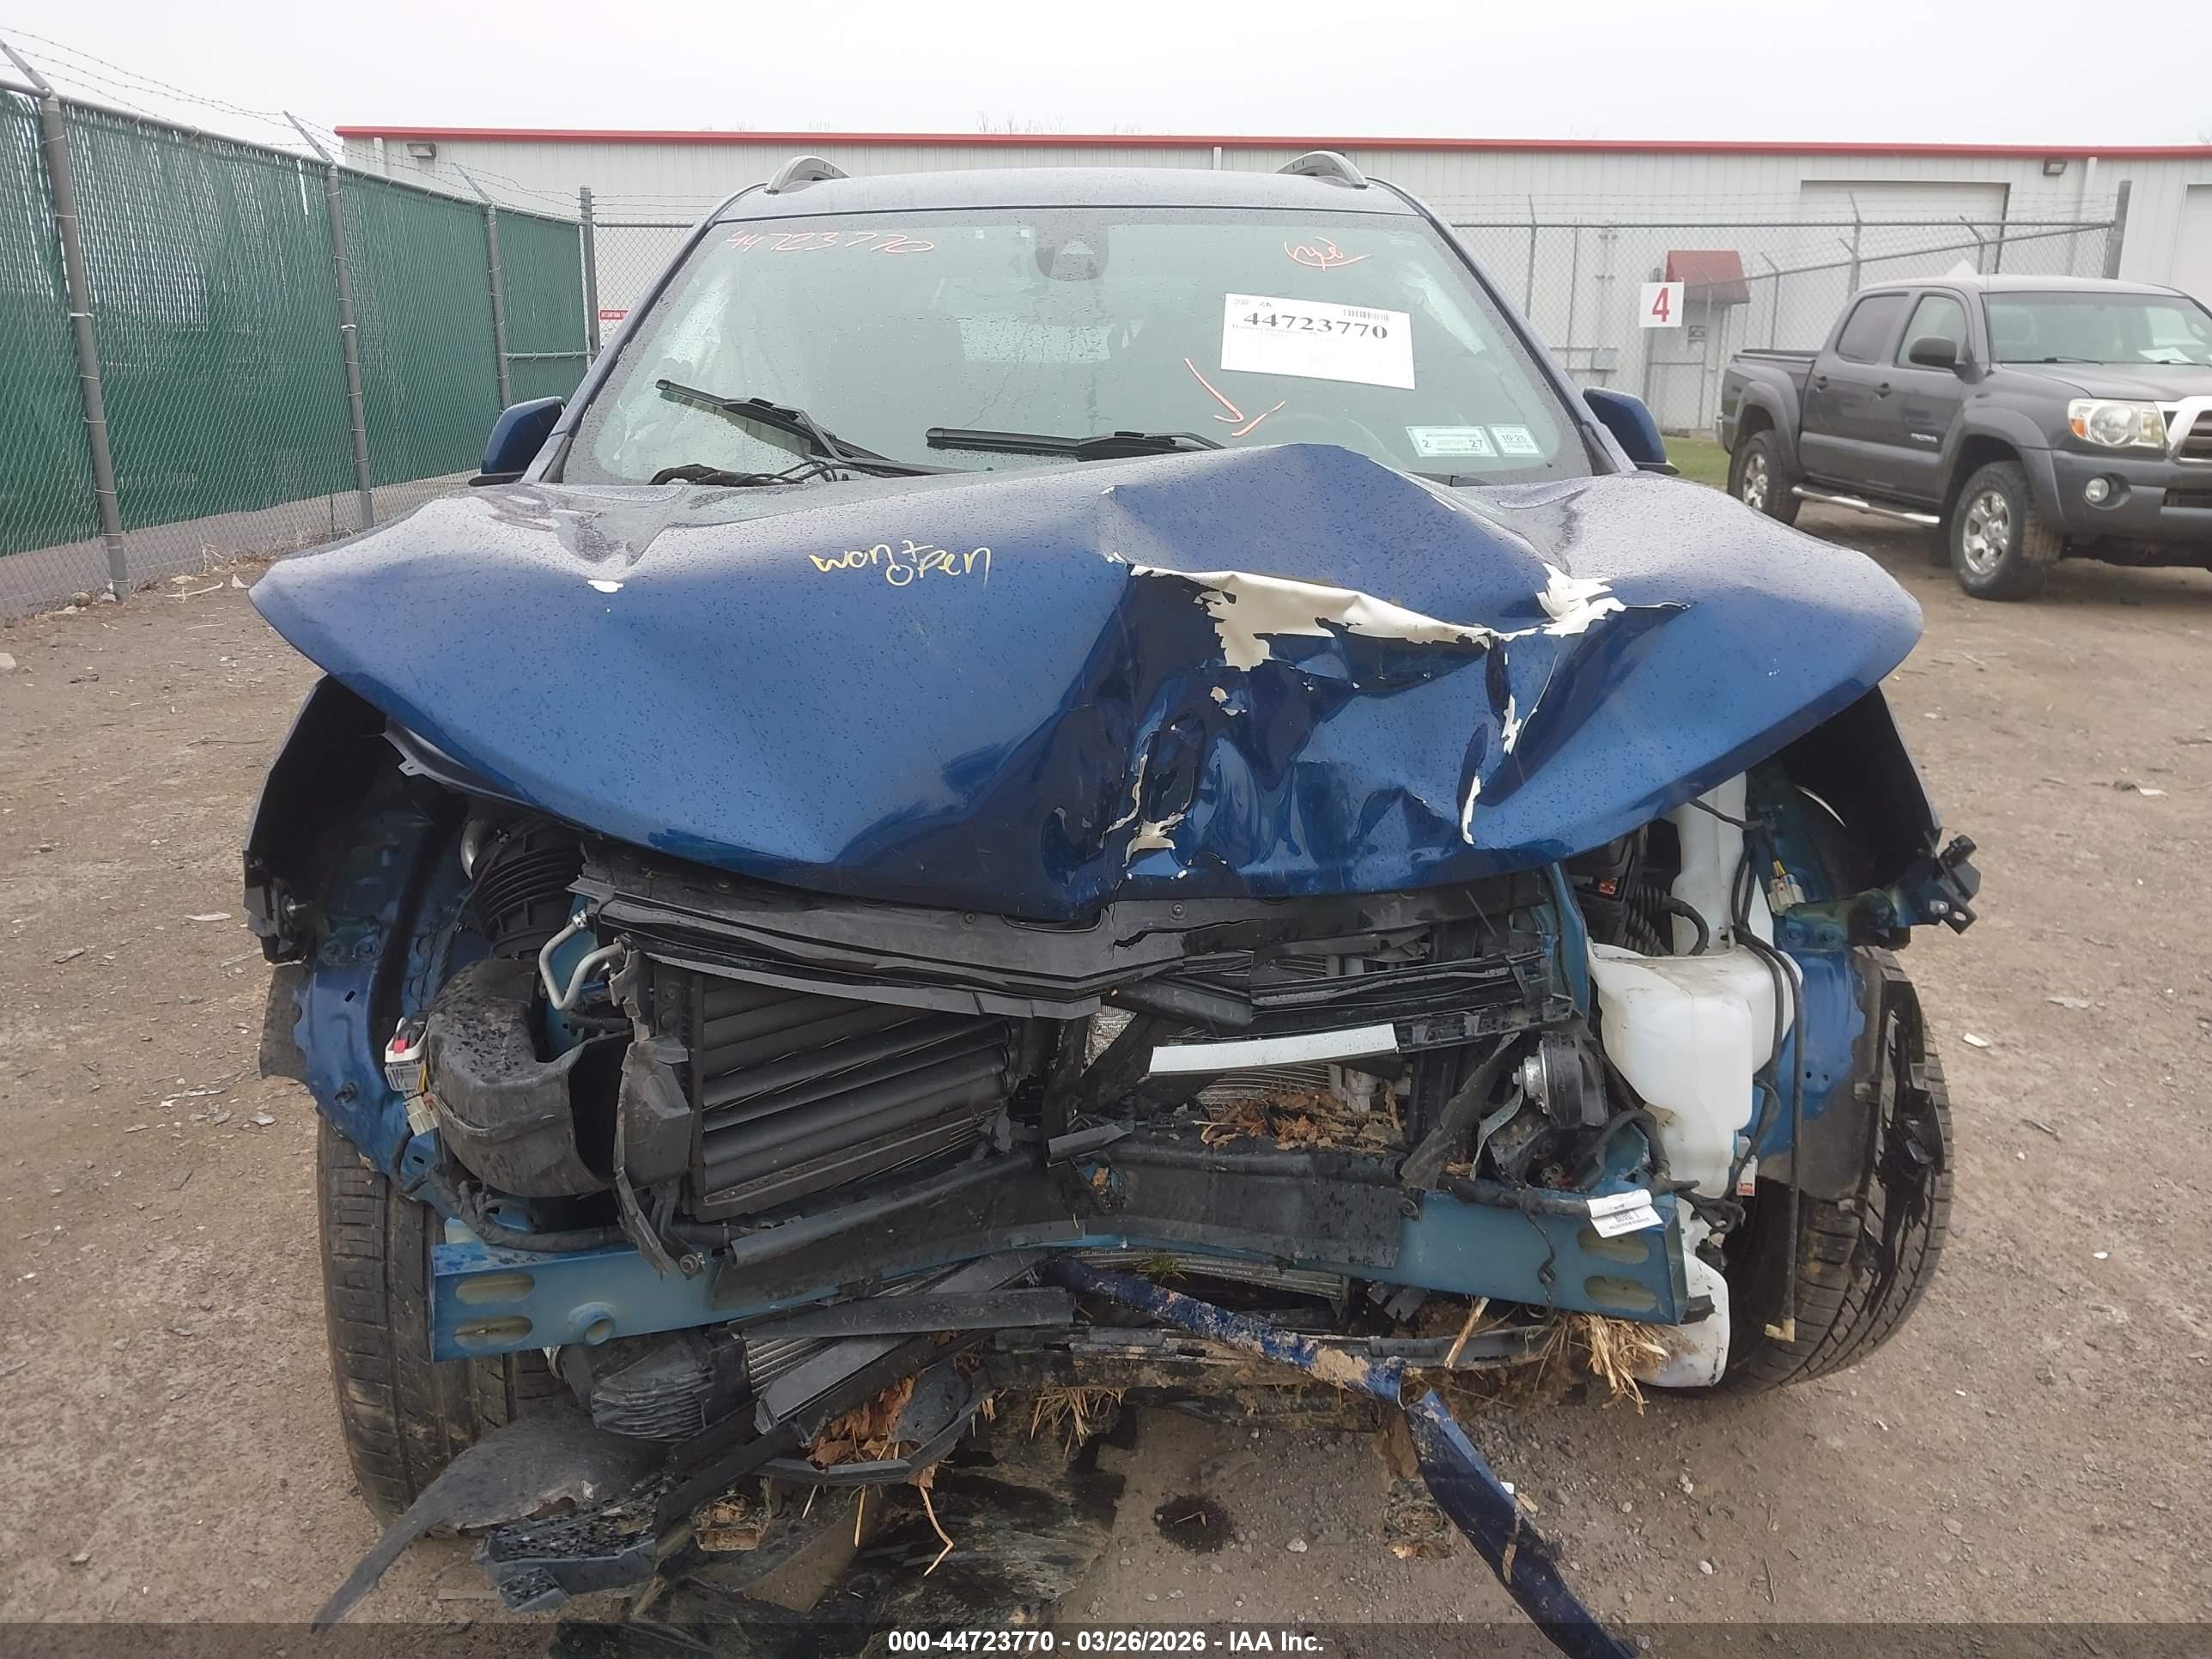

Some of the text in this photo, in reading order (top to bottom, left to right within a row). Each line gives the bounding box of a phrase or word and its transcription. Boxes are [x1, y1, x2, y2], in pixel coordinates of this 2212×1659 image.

[1652, 287, 1670, 323] 4
[1243, 312, 1389, 339] 44723770
[1422, 439, 1484, 448] 2 27
